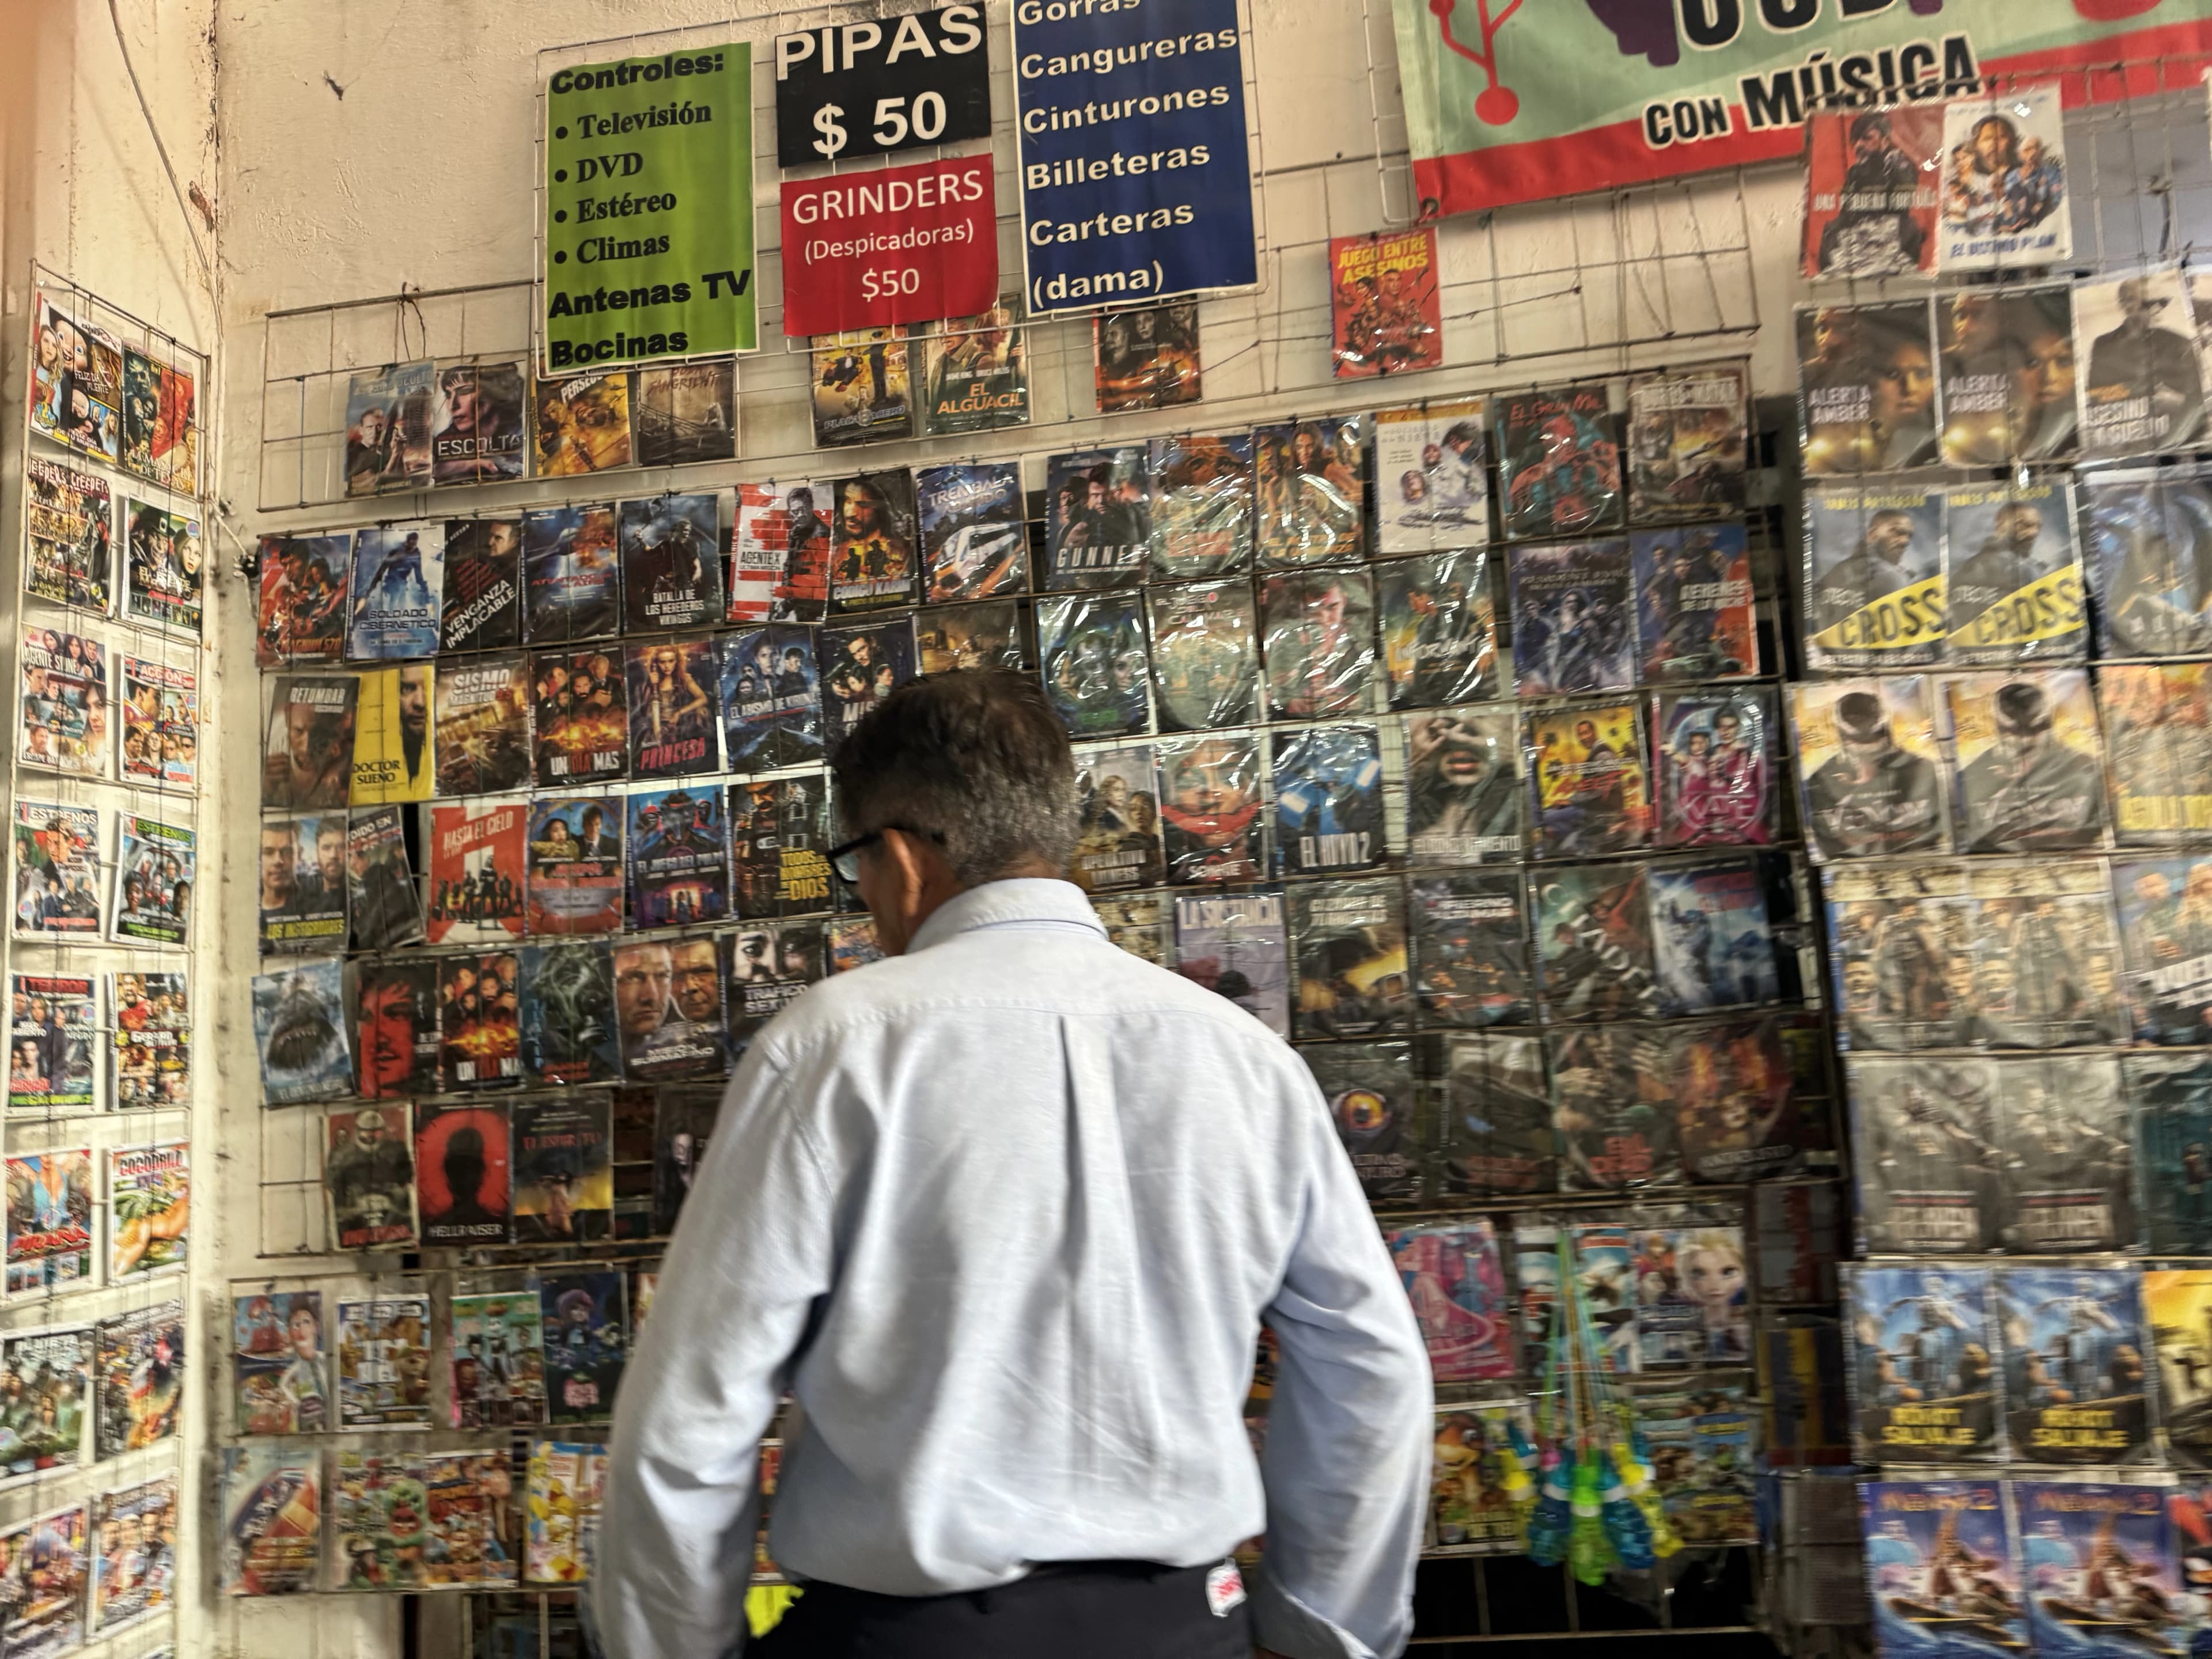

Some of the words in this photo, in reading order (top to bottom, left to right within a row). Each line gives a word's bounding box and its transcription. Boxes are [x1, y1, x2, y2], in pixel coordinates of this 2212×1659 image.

[1017, 0, 1141, 26] Gorras
[777, 5, 982, 81] PIPAS
[1021, 27, 1237, 79] Cangureras
[550, 52, 725, 95] Controles:
[1645, 98, 1729, 145] CON
[1743, 36, 1977, 128] MÚSICA
[578, 100, 712, 141] Televisión
[873, 91, 947, 147] 50
[1023, 85, 1229, 134] Cinturones
[577, 151, 643, 184] DVD
[1027, 143, 1210, 190] Billeteras
[577, 190, 676, 224] Estéreo
[793, 169, 983, 225] GRINDERS
[804, 218, 974, 266] (Despicadoras)
[1030, 204, 1194, 247] Carteras
[577, 231, 671, 264] Climas
[1338, 246, 1379, 268] JUEGO
[1384, 234, 1427, 258] ENTRE
[862, 268, 920, 303] $50
[1032, 261, 1164, 309] (dama)
[1343, 252, 1428, 285] ASESINOS
[549, 281, 691, 318] Antenas
[703, 270, 751, 301] TV
[551, 330, 688, 369] Bocinas
[970, 383, 989, 397] EL
[1810, 385, 1872, 407] ALERTA
[1946, 374, 2010, 396] ALERTA
[937, 393, 1024, 414] ALGUACIL
[1812, 403, 1870, 424] AMBER
[1949, 395, 2007, 414] AMBER
[438, 434, 520, 456] ESCOLTA
[740, 551, 773, 564] AGENTE
[369, 609, 428, 619] SOLDADO
[446, 579, 511, 633] VENGANZA
[446, 587, 516, 649] IMPLACABLE
[646, 605, 660, 615] LOS
[1840, 587, 1945, 647] CROSS
[1975, 578, 2081, 644] CROSS
[453, 669, 510, 695] SISMO
[352, 760, 401, 773] DOCTOR
[550, 755, 569, 775] UN
[639, 737, 705, 770] PRINCESA
[444, 825, 473, 849] HASTA
[474, 821, 484, 839] EL
[487, 810, 514, 834] CIELO
[1300, 836, 1318, 869] EL
[1358, 832, 1371, 863] 2
[790, 877, 830, 901] DIOS
[120, 1150, 182, 1176] COCODRILO
